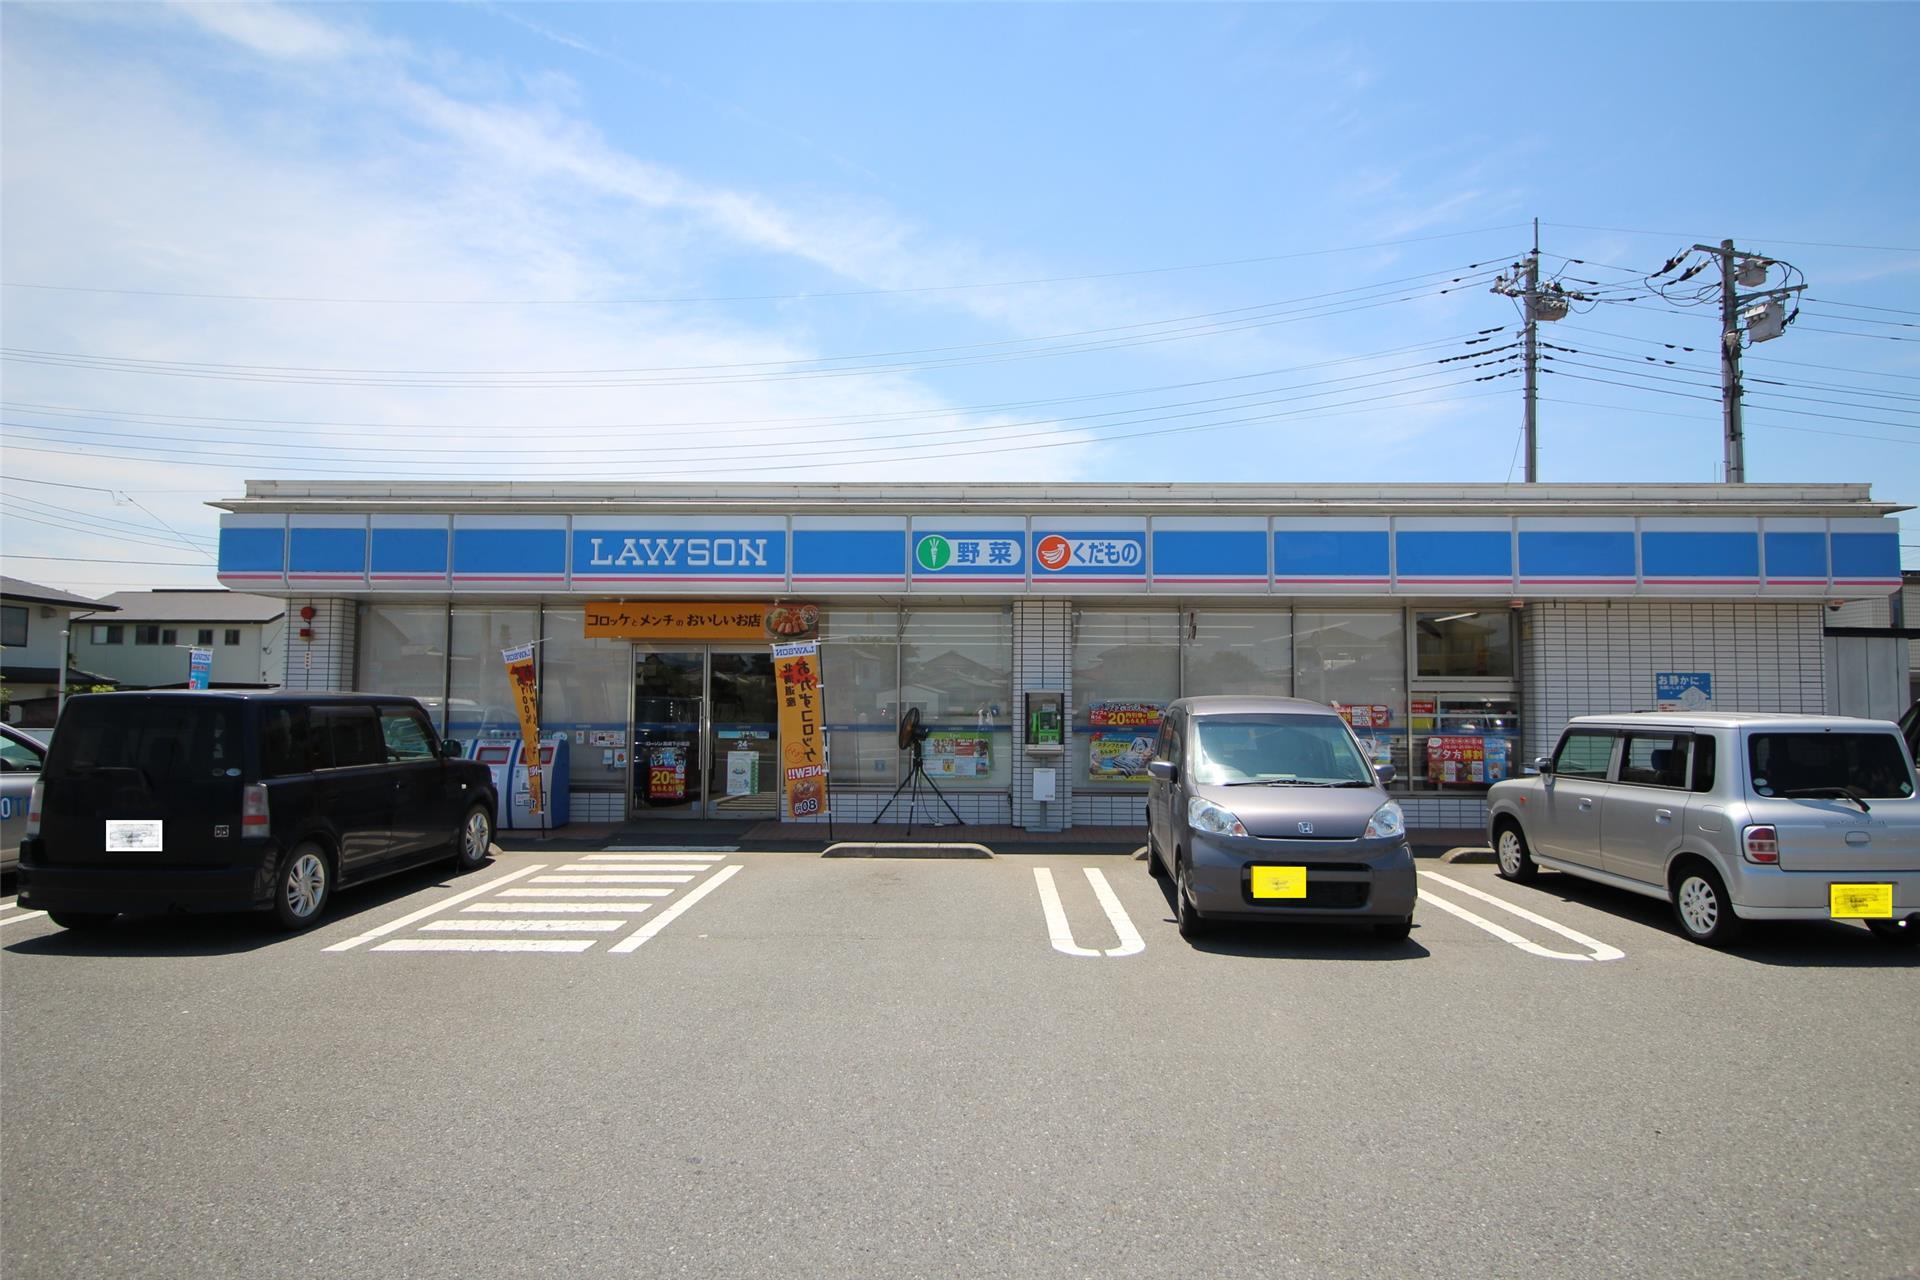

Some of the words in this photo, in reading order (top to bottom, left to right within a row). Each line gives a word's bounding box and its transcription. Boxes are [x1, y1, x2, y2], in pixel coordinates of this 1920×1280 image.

[590, 538, 768, 566] LAWSON
[957, 541, 1012, 564] 野菜
[1073, 541, 1137, 564] くだもの
[1658, 675, 1700, 686] お静かに
[1107, 712, 1126, 725] 20
[651, 771, 670, 785] 20
